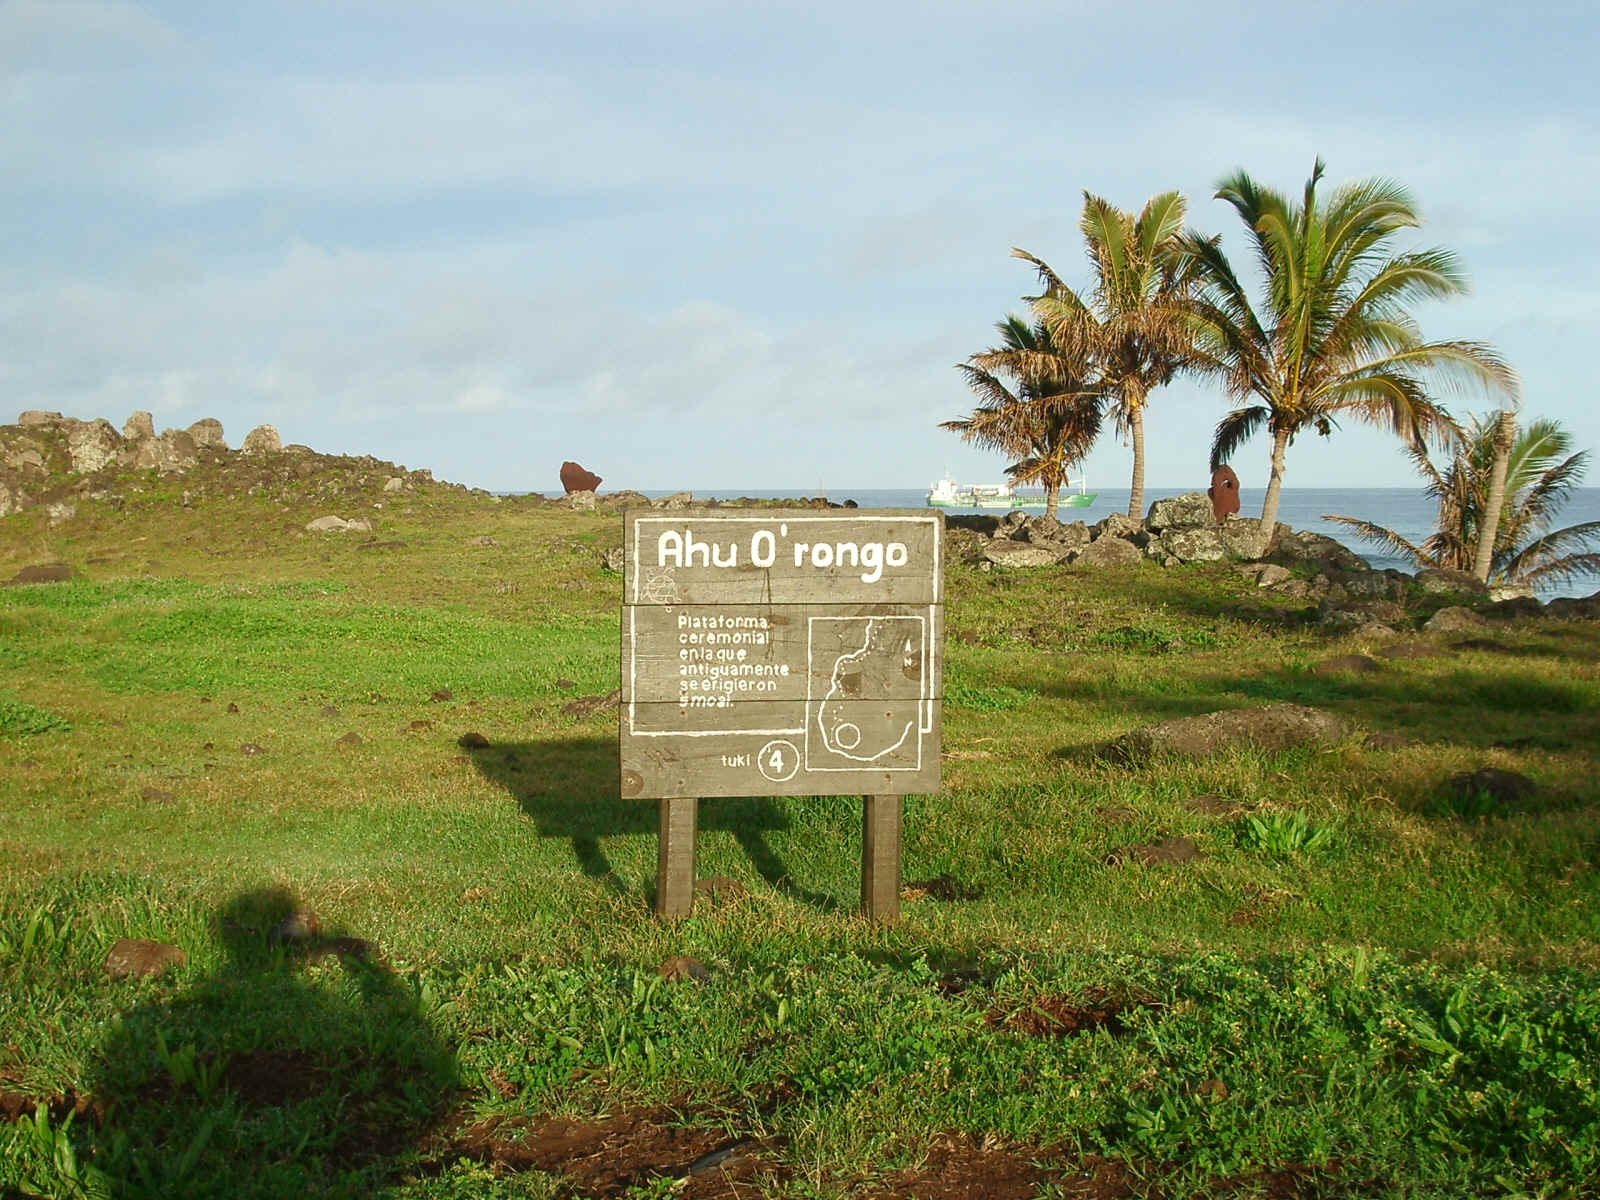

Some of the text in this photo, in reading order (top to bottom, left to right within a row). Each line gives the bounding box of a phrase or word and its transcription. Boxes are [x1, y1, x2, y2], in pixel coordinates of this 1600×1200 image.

[658, 529, 737, 567] Ahu
[678, 615, 768, 629] Plataforma
[679, 631, 769, 644] ceremonial
[680, 647, 747, 662] en la que
[680, 664, 789, 680] antiguamente
[680, 679, 776, 694] se erigieron
[720, 749, 784, 773] tuki 4
